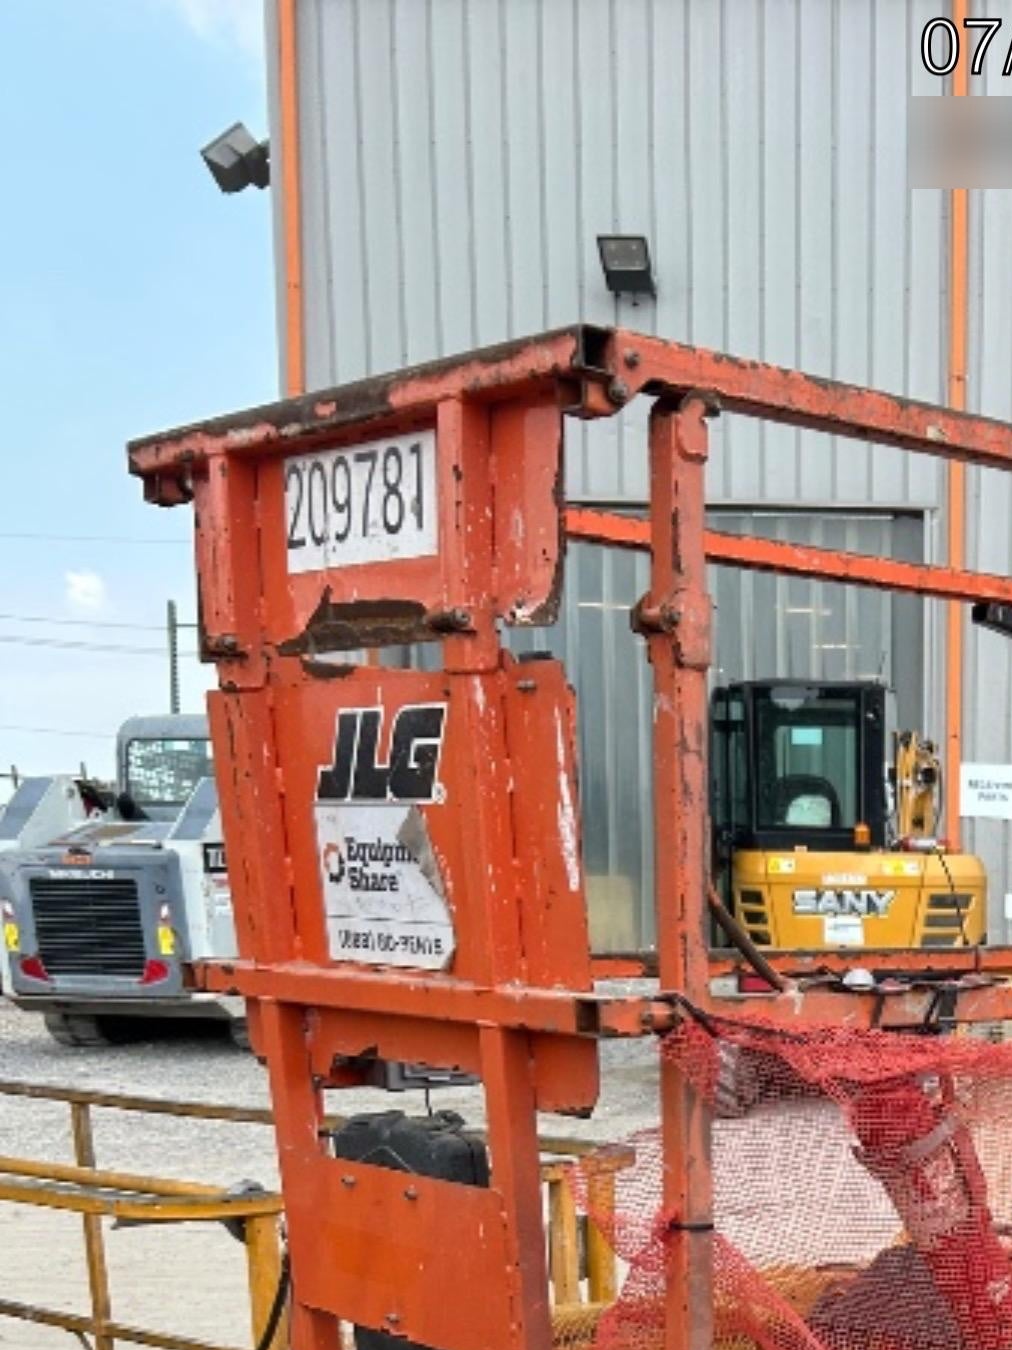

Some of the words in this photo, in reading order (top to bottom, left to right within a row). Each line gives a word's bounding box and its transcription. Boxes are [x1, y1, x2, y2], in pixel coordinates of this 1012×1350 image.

[284, 442, 424, 549] 209781
[315, 702, 447, 804] JLG
[344, 836, 420, 867] Equipm
[347, 867, 400, 892] Share
[791, 888, 898, 915] SANY
